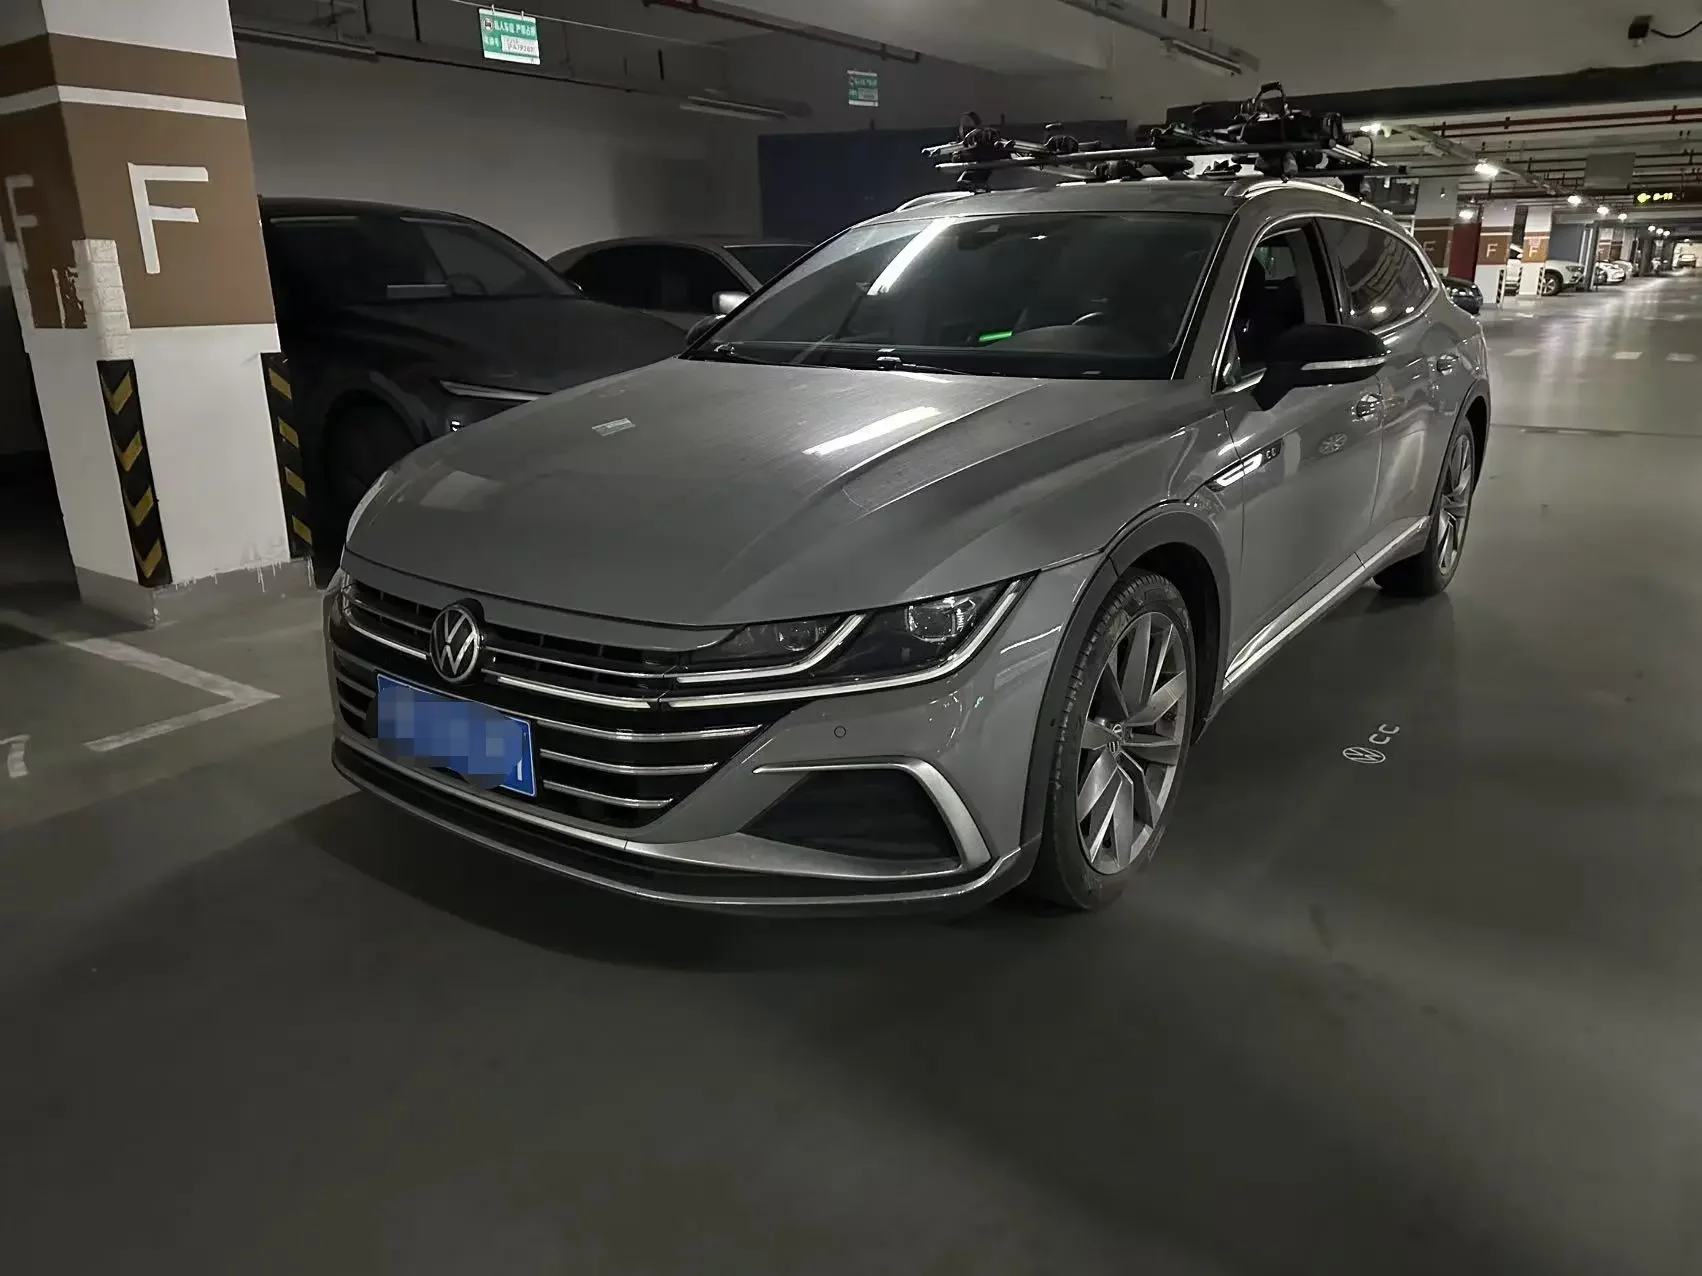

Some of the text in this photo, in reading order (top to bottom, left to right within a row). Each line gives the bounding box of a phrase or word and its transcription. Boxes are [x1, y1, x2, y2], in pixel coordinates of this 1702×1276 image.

[4, 174, 39, 271] F
[127, 162, 209, 275] F
[1486, 243, 1498, 258] F
[1529, 245, 1539, 257] F
[1368, 723, 1400, 745] CC
